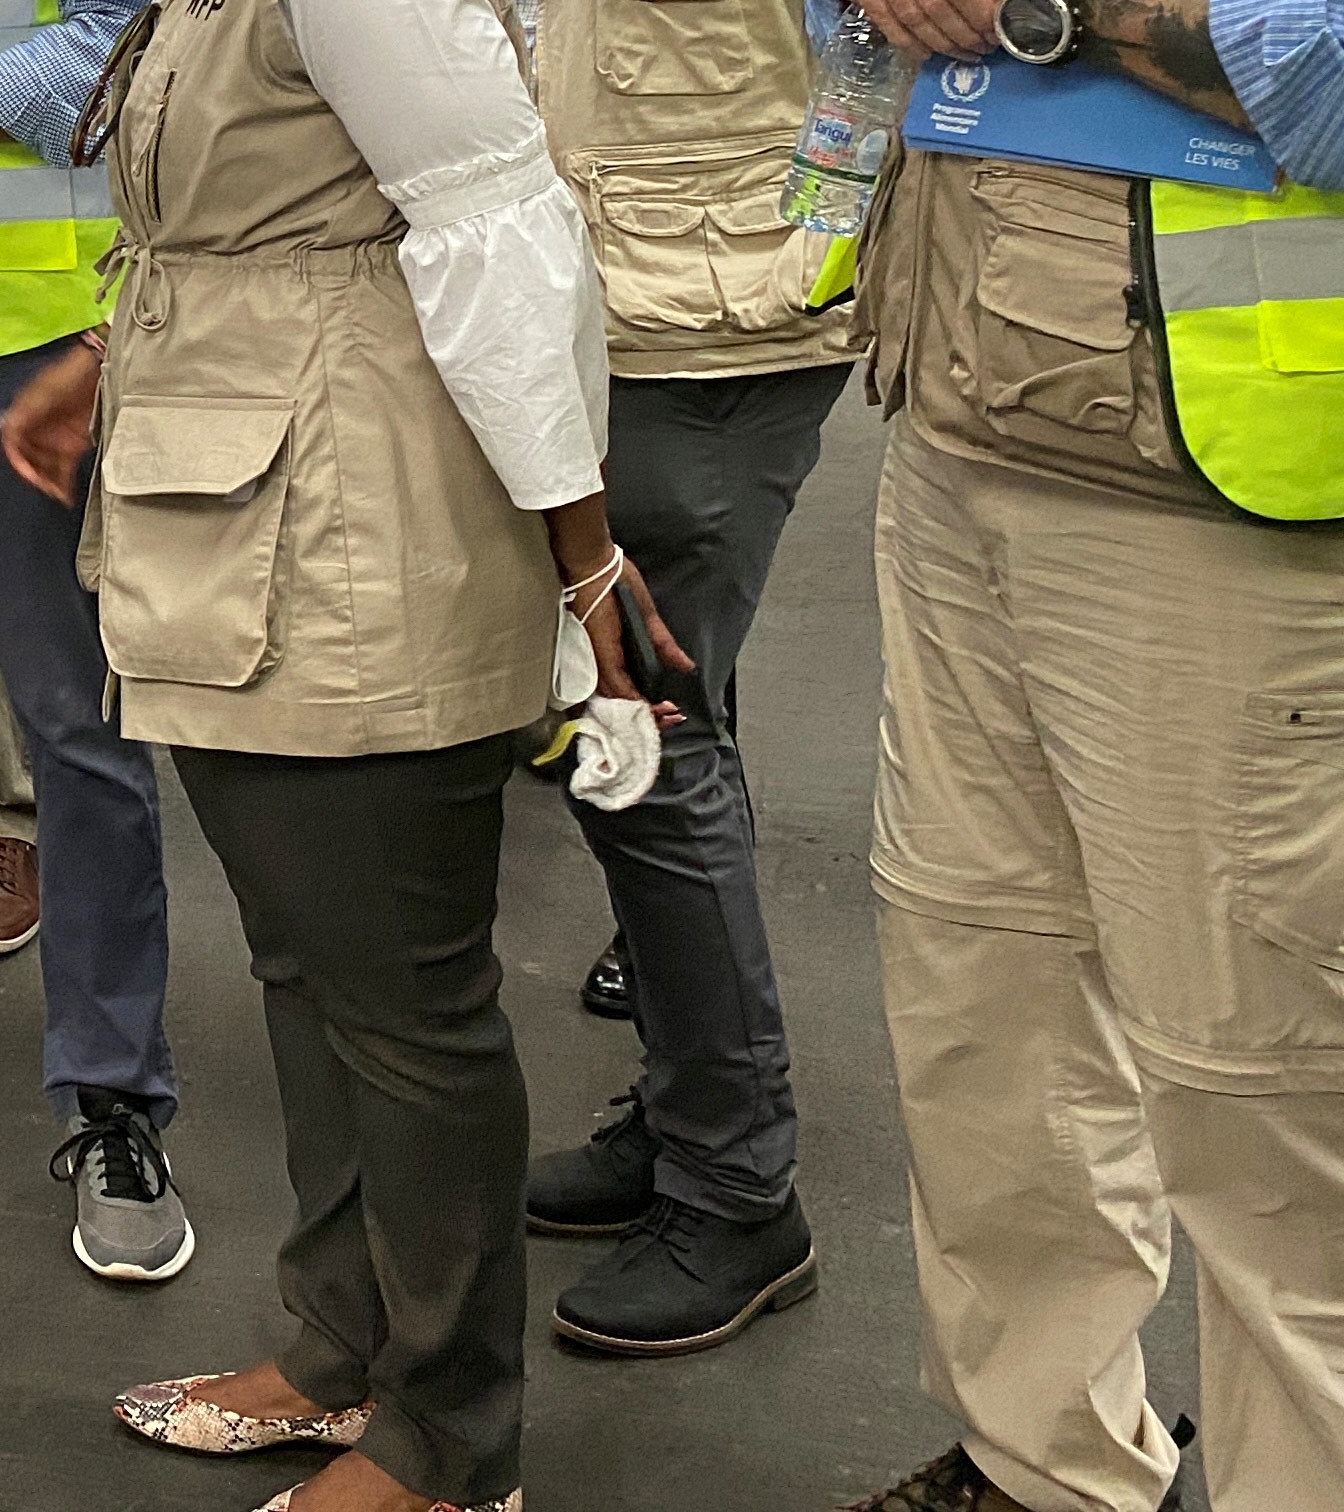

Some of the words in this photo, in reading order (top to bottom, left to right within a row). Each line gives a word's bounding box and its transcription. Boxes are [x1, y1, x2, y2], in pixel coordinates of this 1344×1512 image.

[1189, 138, 1256, 156] CHANGER
[1185, 152, 1210, 165] LES
[1212, 156, 1240, 170] VIES
